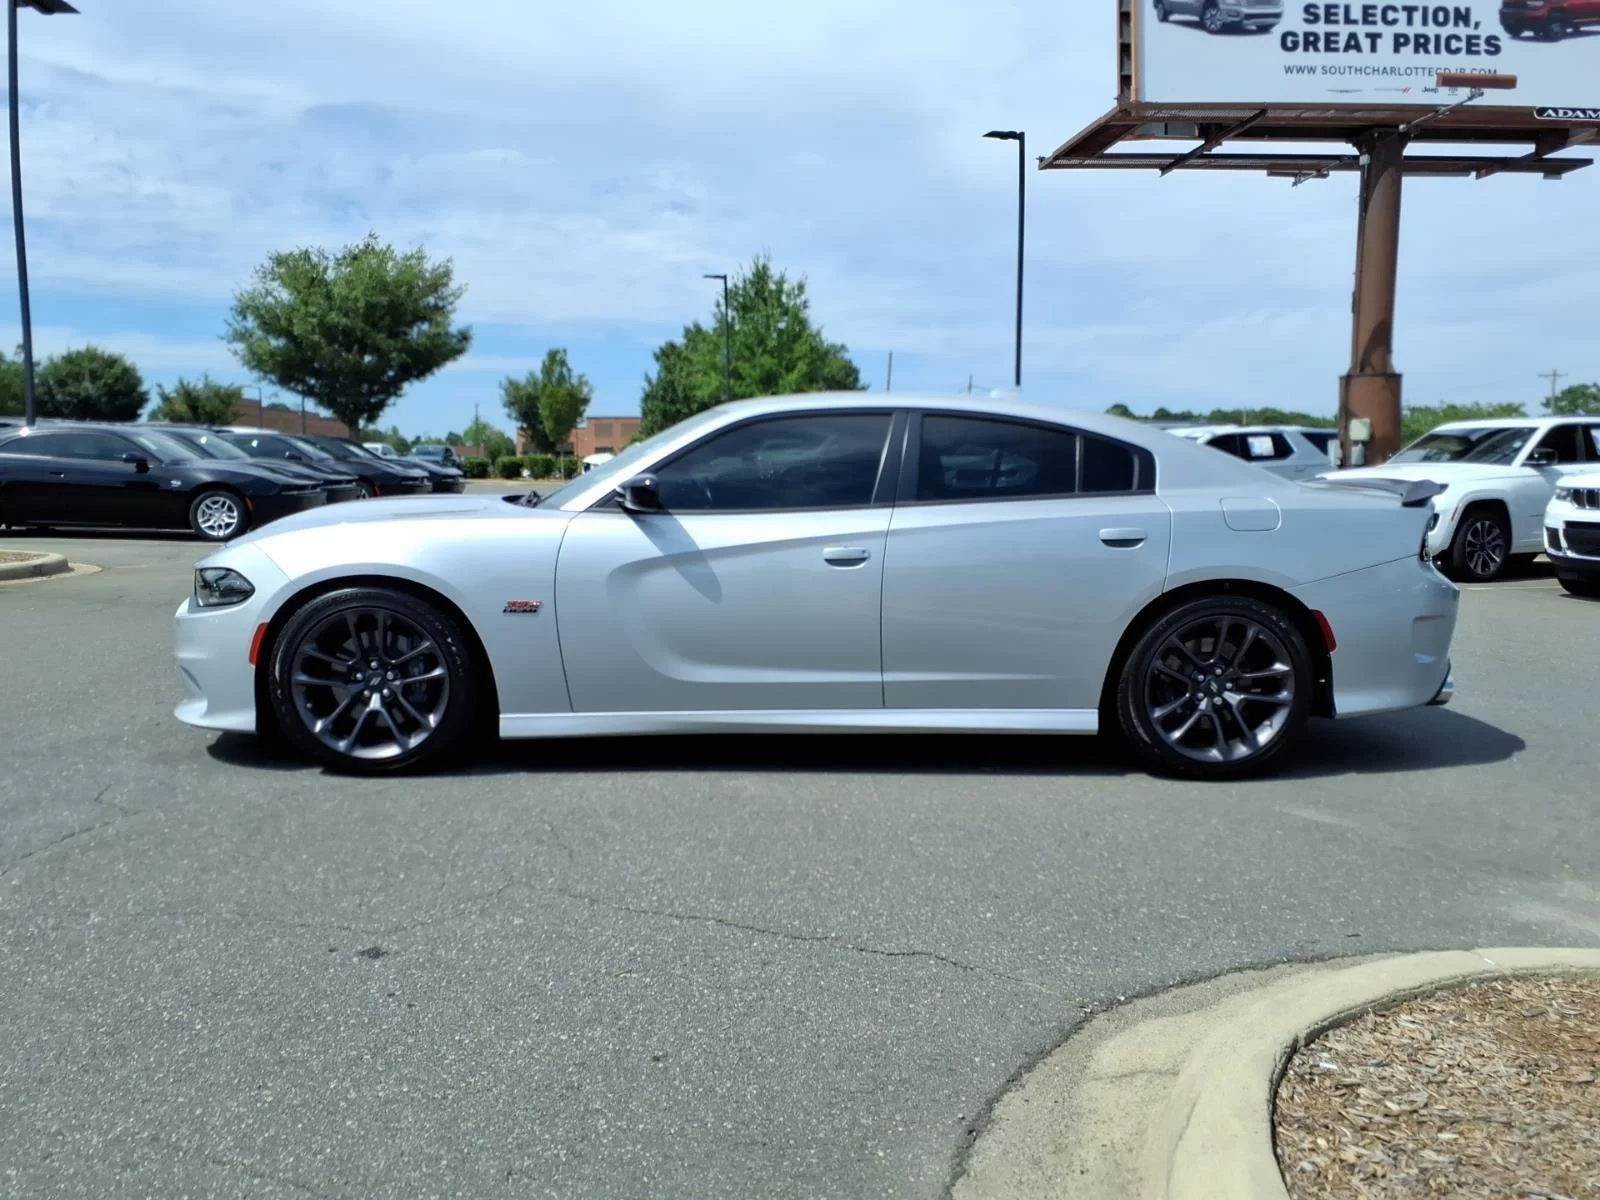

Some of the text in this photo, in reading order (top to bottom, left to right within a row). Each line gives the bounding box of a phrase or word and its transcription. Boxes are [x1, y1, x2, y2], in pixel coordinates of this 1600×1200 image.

[1302, 3, 1482, 31] SELECTION,
[1280, 30, 1502, 57] GREAT PRICES
[1421, 86, 1440, 94] Jeep
